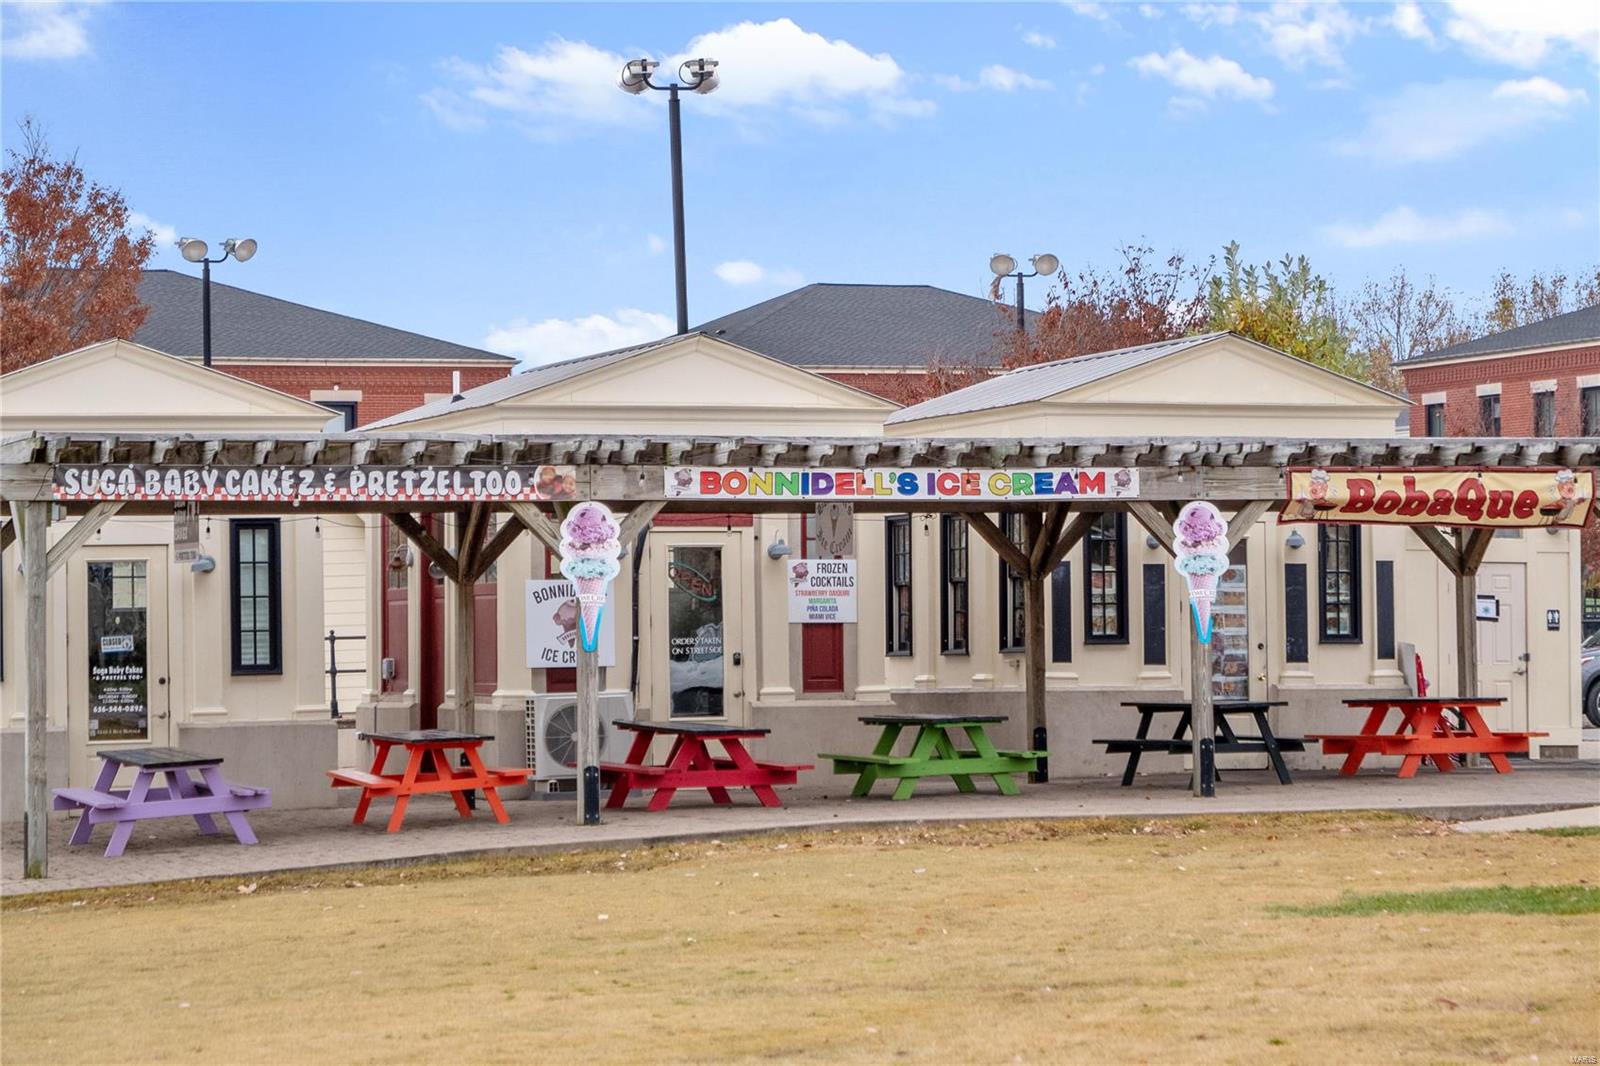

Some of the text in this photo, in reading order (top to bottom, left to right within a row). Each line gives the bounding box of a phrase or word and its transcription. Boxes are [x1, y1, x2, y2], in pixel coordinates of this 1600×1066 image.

[64, 468, 136, 496] SUGA
[144, 469, 218, 497] BABY
[225, 469, 315, 497] CAKEZ
[349, 469, 468, 497] PRETZEL
[469, 469, 522, 497] TOO
[699, 471, 1105, 496] BONNIDELL'S ICE CREAM
[1339, 476, 1539, 521] BobaQue
[817, 563, 848, 574] FROZEN
[811, 577, 854, 588] COCKTAILS
[672, 637, 700, 645] ORDERS
[541, 647, 559, 662] ICE
[672, 647, 684, 655] ON
